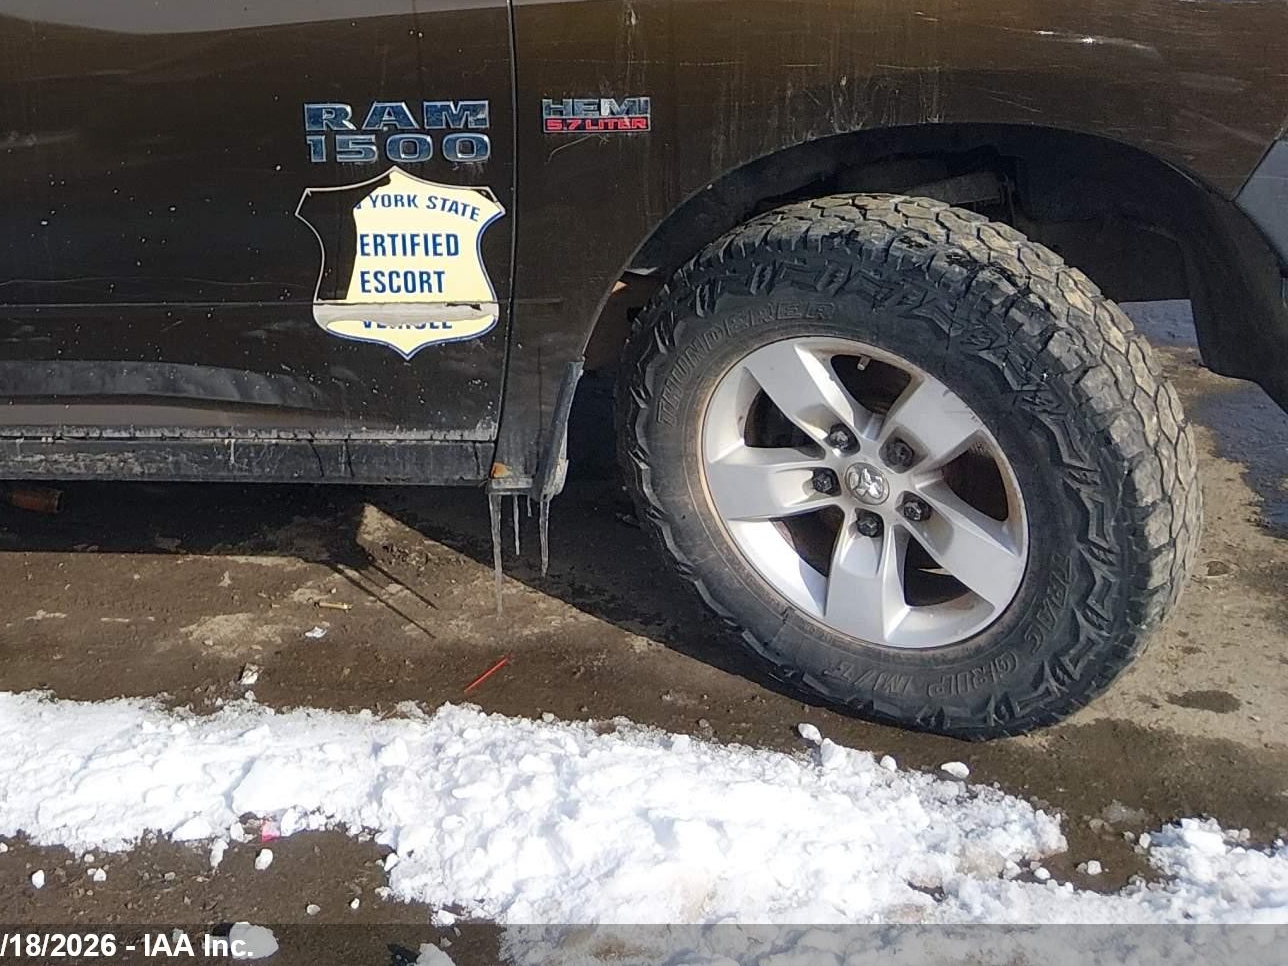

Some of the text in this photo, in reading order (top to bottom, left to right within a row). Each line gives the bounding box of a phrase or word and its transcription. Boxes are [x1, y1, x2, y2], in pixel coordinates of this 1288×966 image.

[304, 100, 490, 131] RAM
[542, 97, 651, 117] HEMI
[546, 118, 647, 131] 5.7 LITER
[306, 133, 491, 163] 1500
[369, 193, 481, 222] YORK STATE
[359, 233, 460, 257] ERTIFIED
[360, 270, 446, 294] ESCORT
